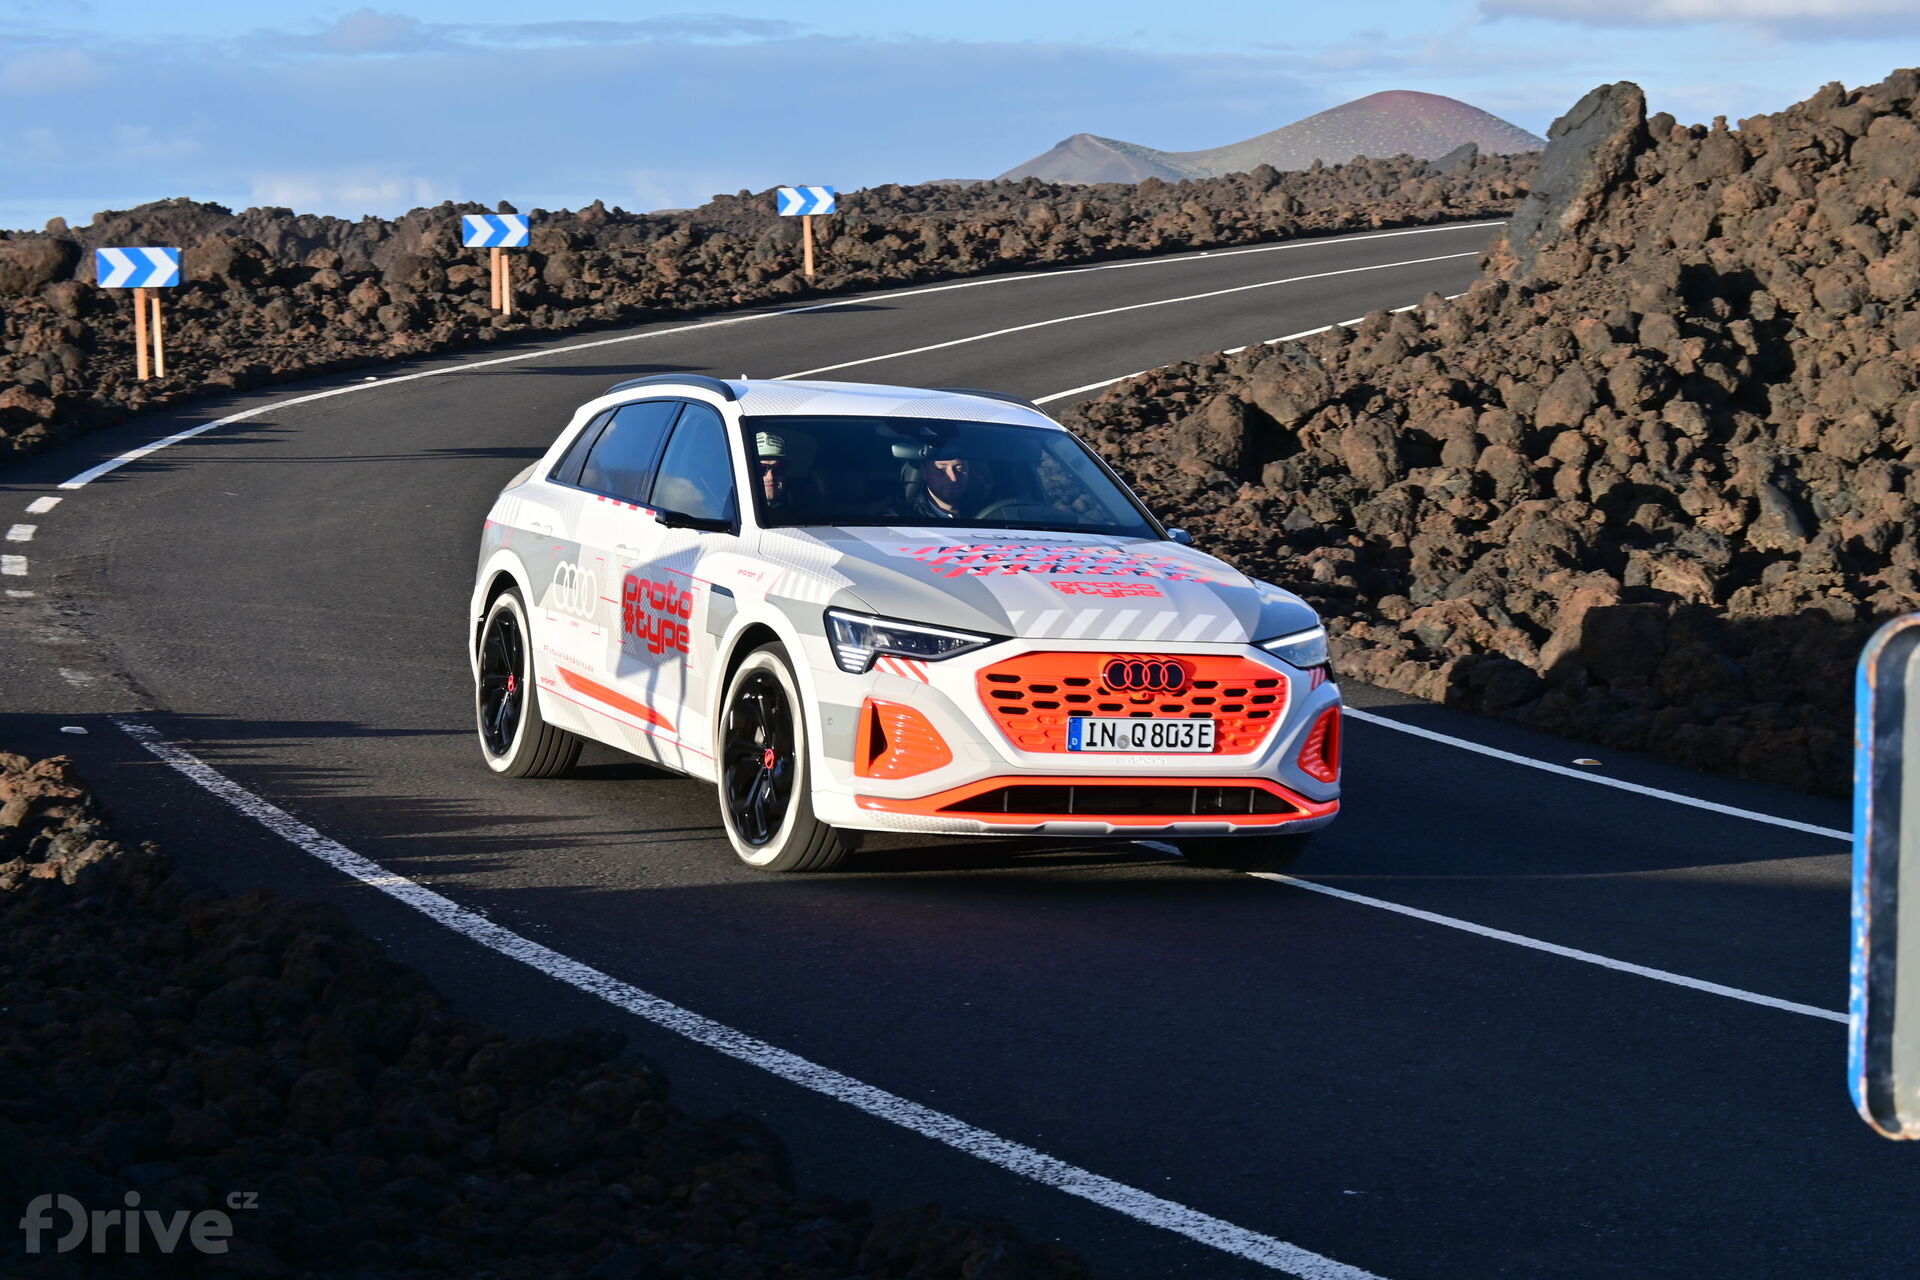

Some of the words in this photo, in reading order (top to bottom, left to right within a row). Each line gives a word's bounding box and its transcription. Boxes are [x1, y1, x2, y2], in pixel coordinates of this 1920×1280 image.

[622, 574, 693, 620] proto
[1049, 581, 1155, 592] proto
[1060, 587, 1165, 599] #type
[623, 603, 690, 654] #type
[1086, 722, 1116, 747] IN
